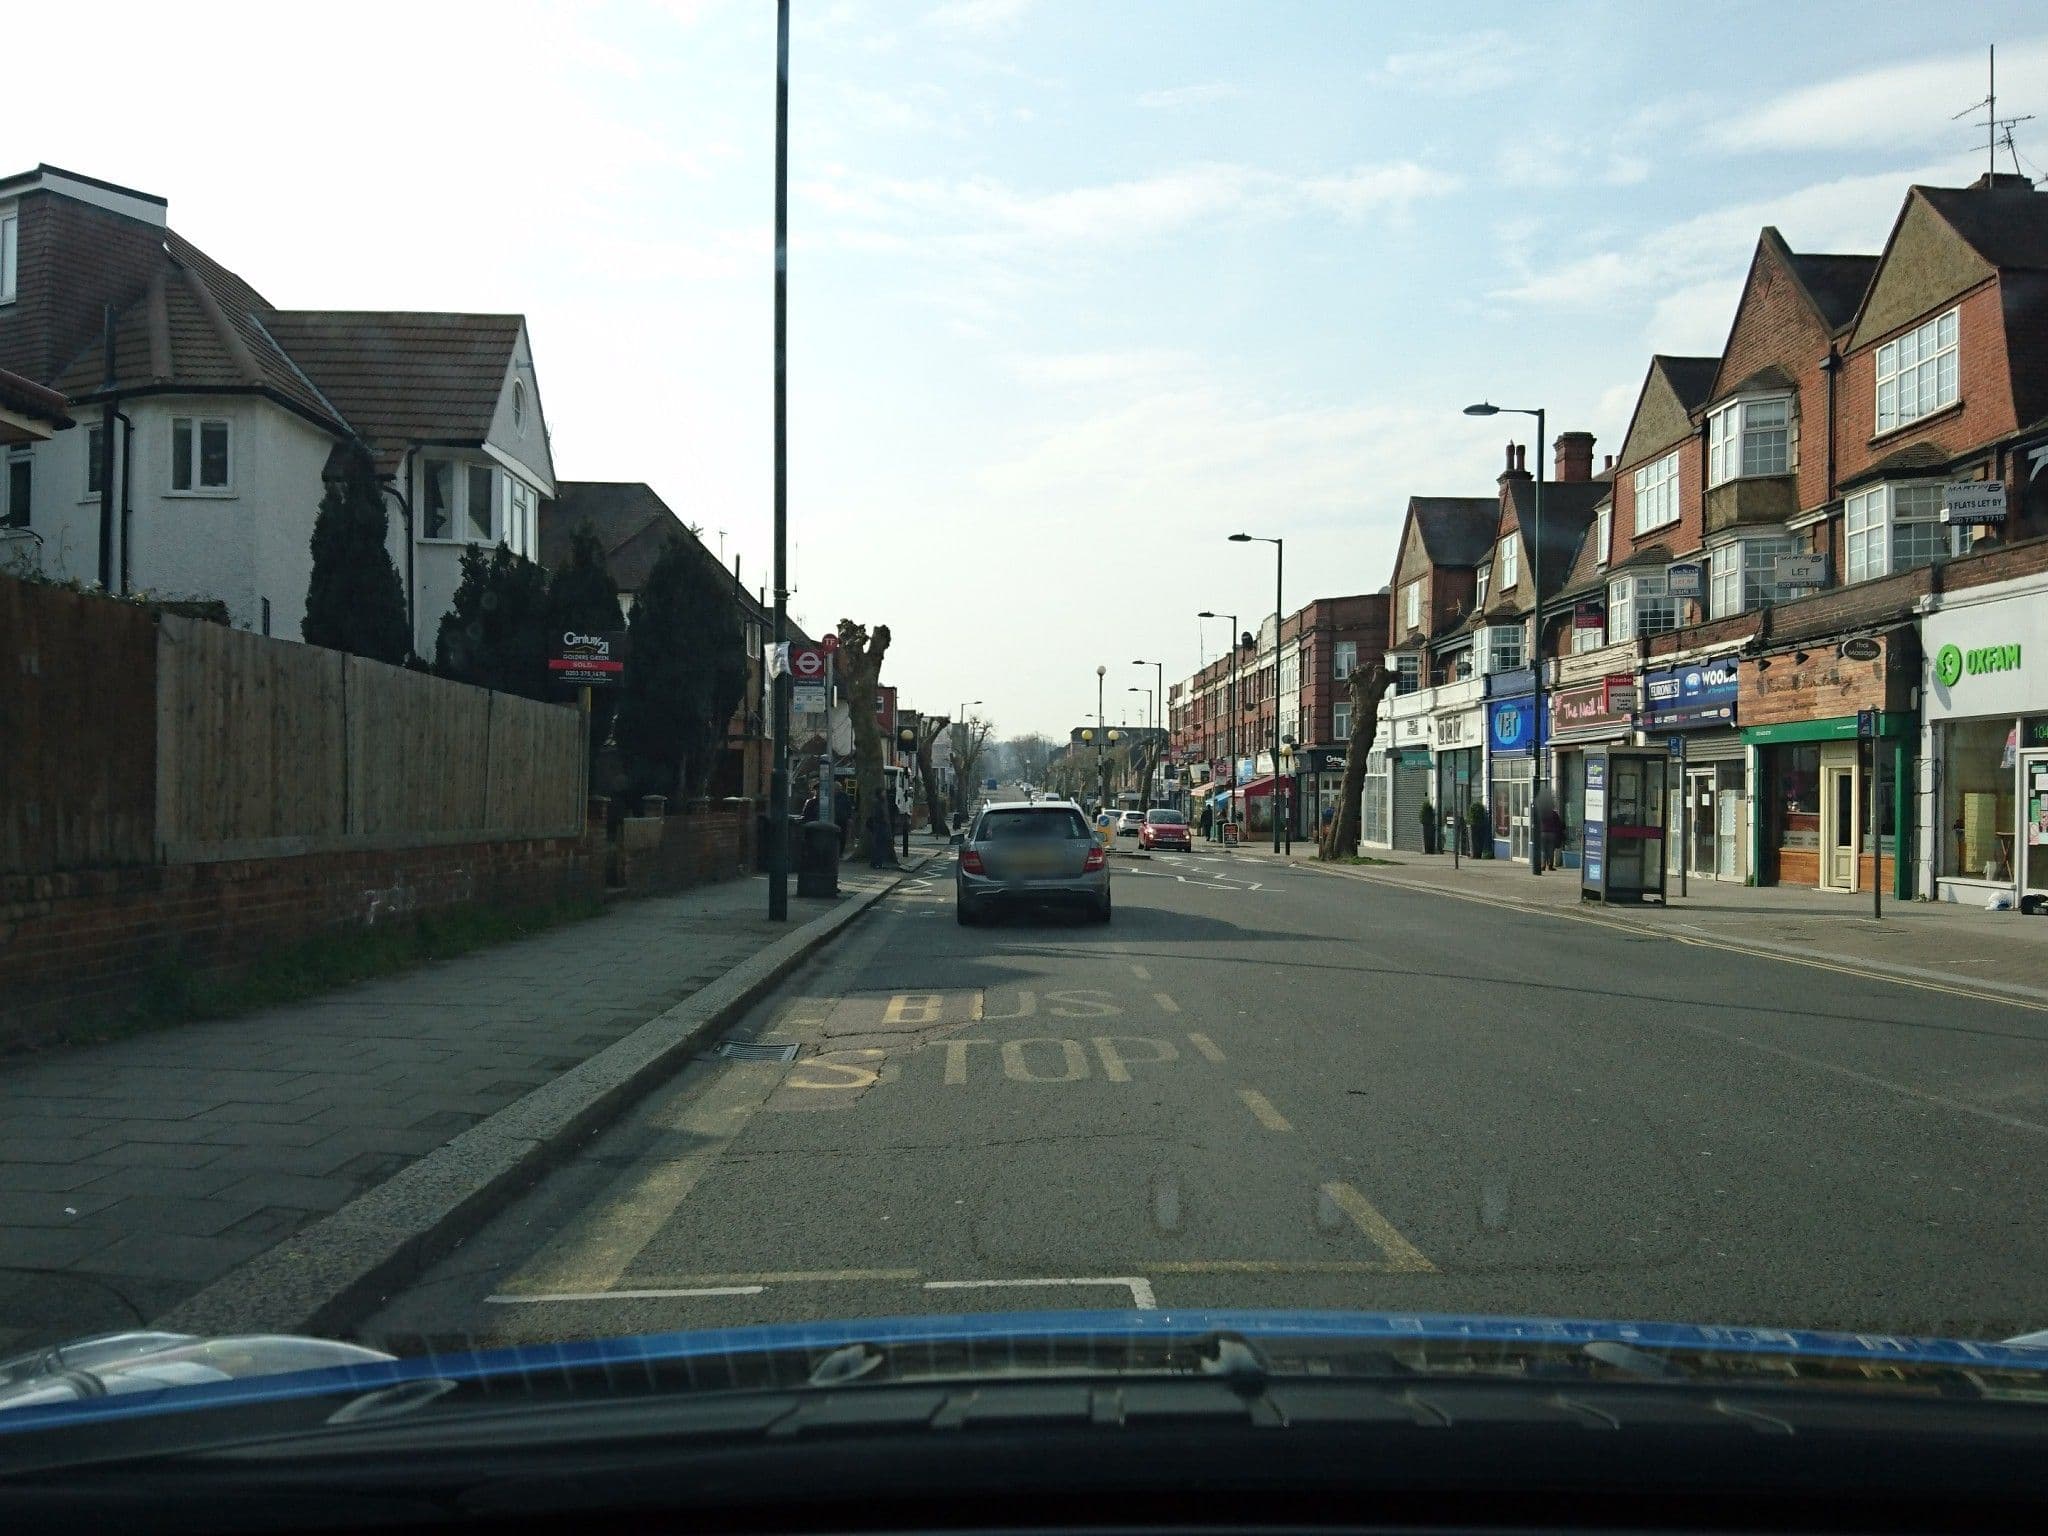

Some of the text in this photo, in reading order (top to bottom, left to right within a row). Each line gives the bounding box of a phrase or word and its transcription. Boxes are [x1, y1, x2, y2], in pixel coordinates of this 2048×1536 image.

[1955, 500, 1976, 509] FLATS
[1978, 499, 1991, 507] LET
[1993, 498, 2002, 506] BY
[1791, 567, 1810, 576] LET
[563, 632, 602, 646] Century
[597, 642, 609, 654] 21
[1966, 644, 2021, 675] OXFAM
[1563, 703, 1578, 719] The
[1580, 697, 1596, 718] Nail
[1498, 711, 1518, 737] VET
[883, 989, 1126, 1025] BUS
[786, 1036, 1183, 1090] STOP
